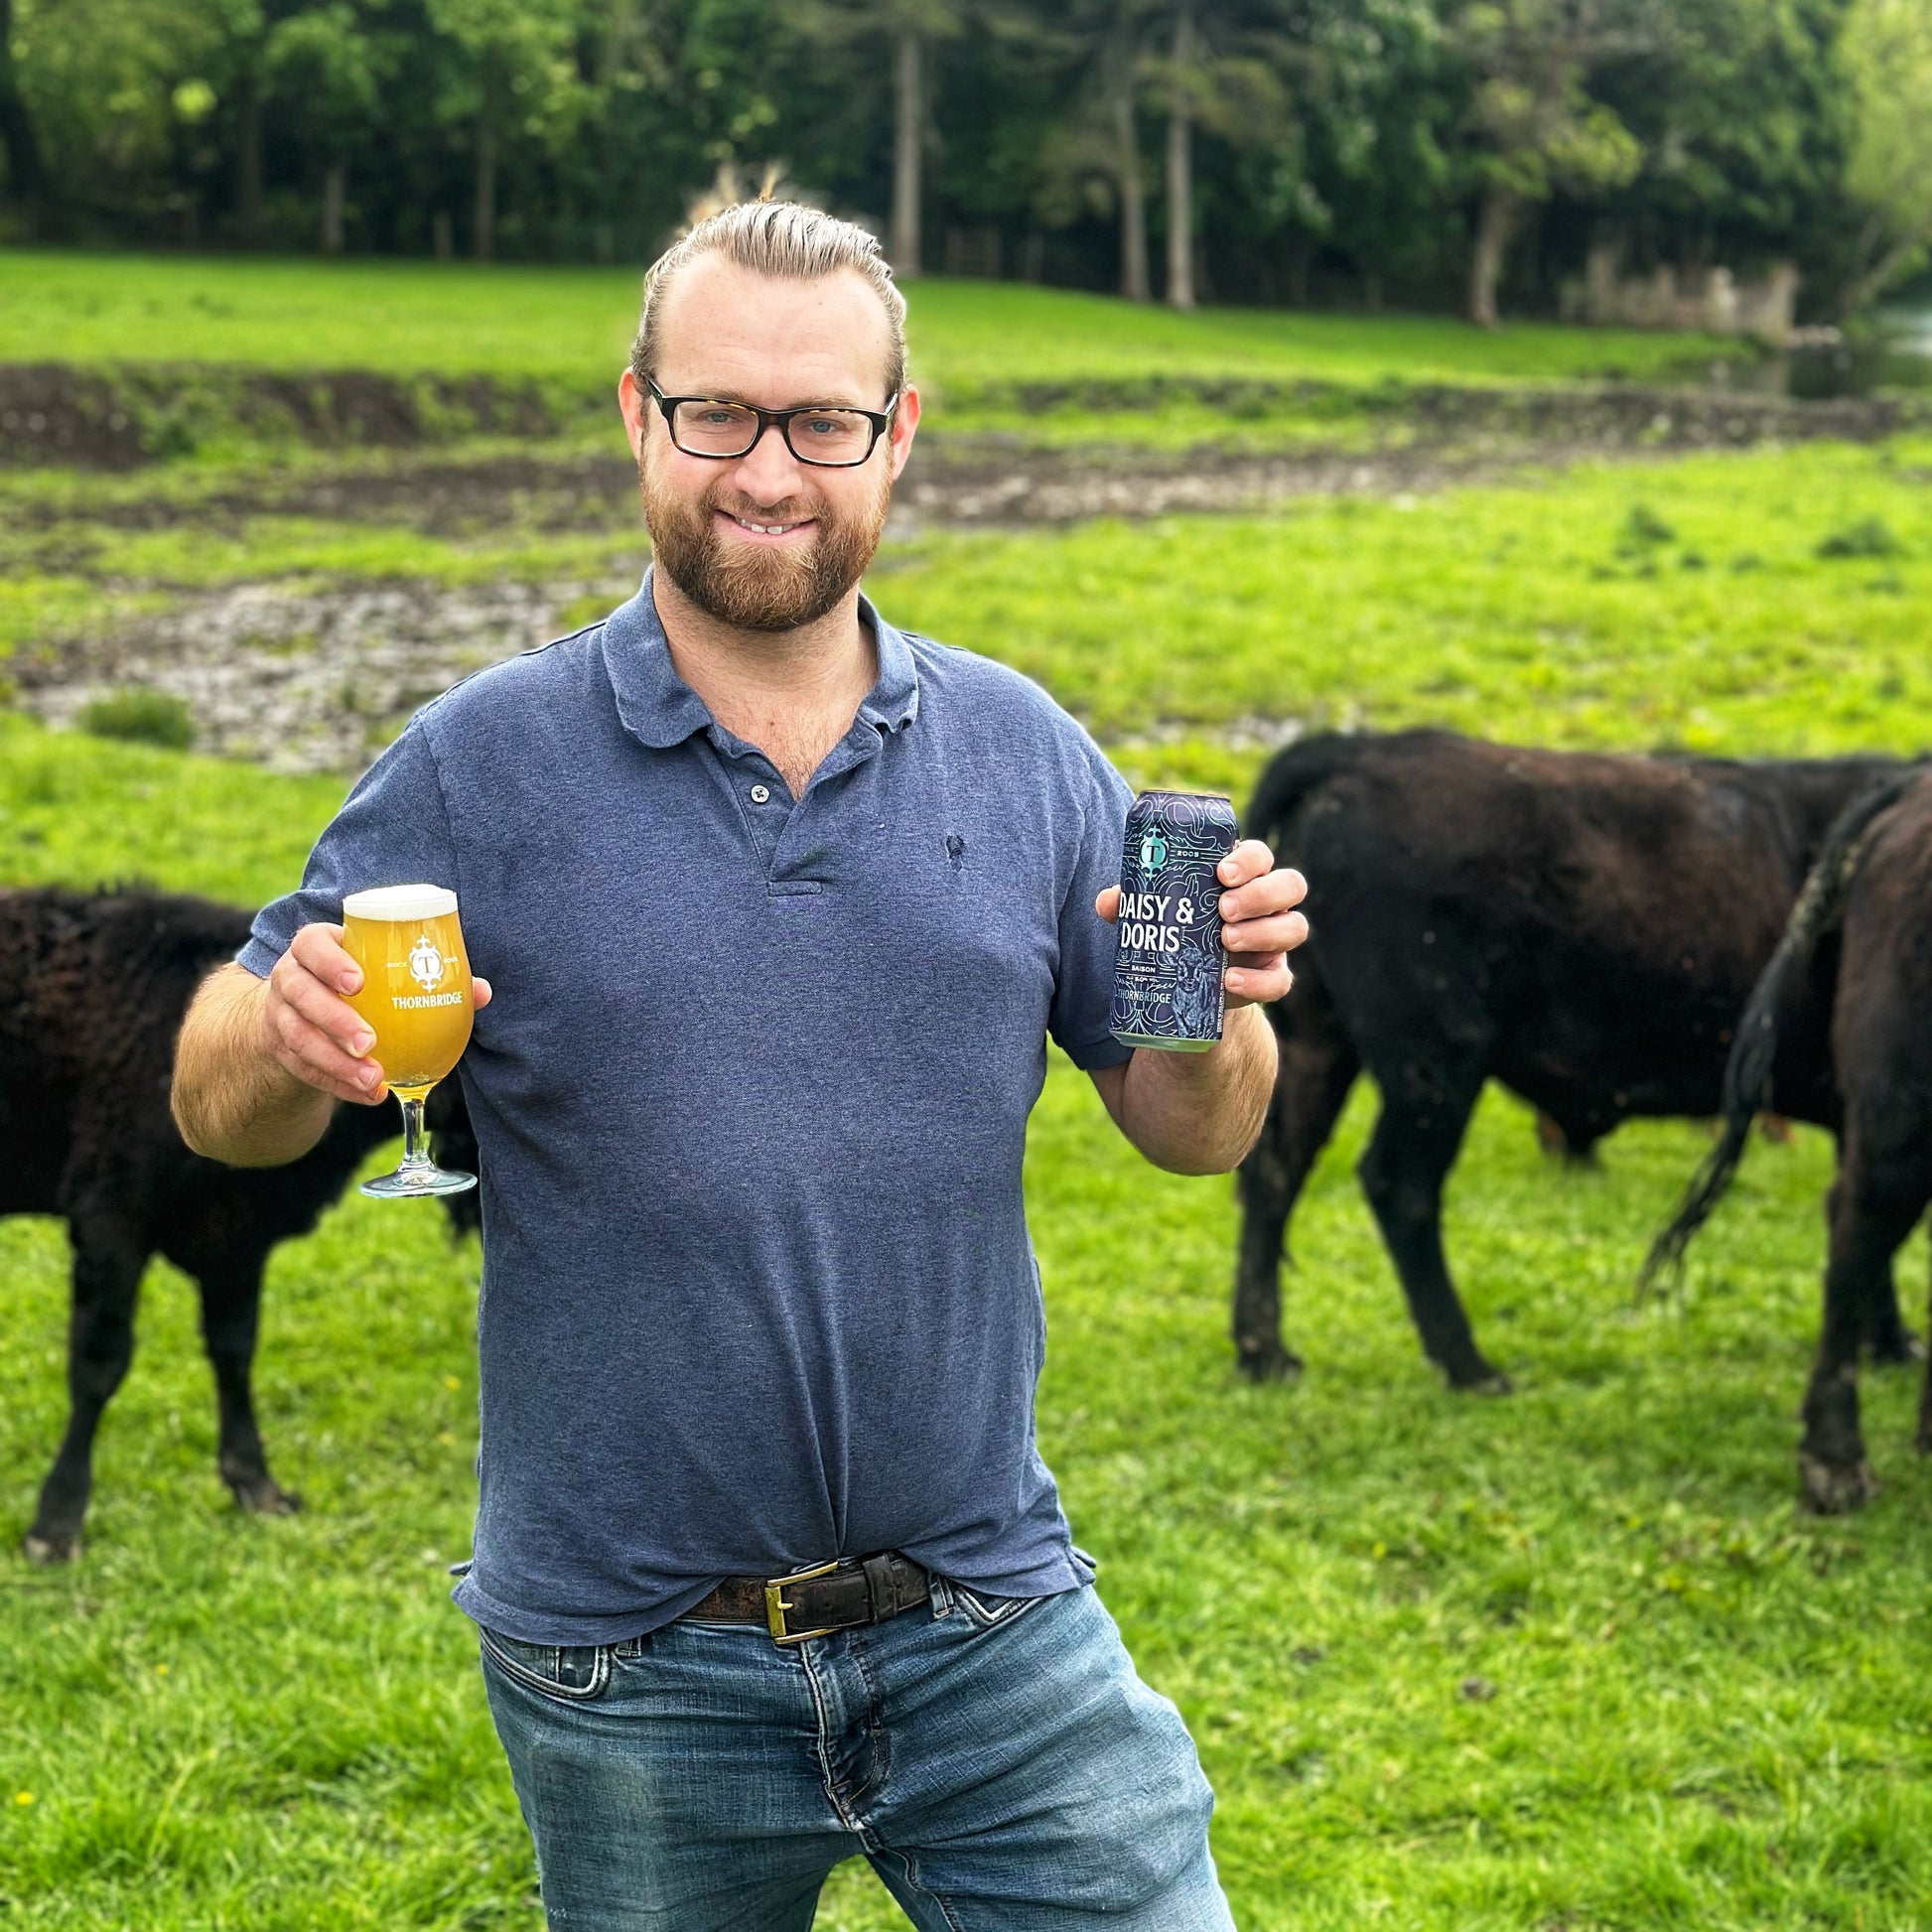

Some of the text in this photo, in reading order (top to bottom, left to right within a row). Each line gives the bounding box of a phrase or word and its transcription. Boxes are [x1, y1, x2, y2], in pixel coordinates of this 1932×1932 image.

[1147, 845, 1161, 863] T
[1119, 892, 1194, 924] DAISY &
[1121, 921, 1180, 953] DORIS
[418, 955, 434, 974] T
[391, 991, 463, 1010] THORNBRIDGE
[1118, 989, 1173, 1004] THORNBRIDGE
